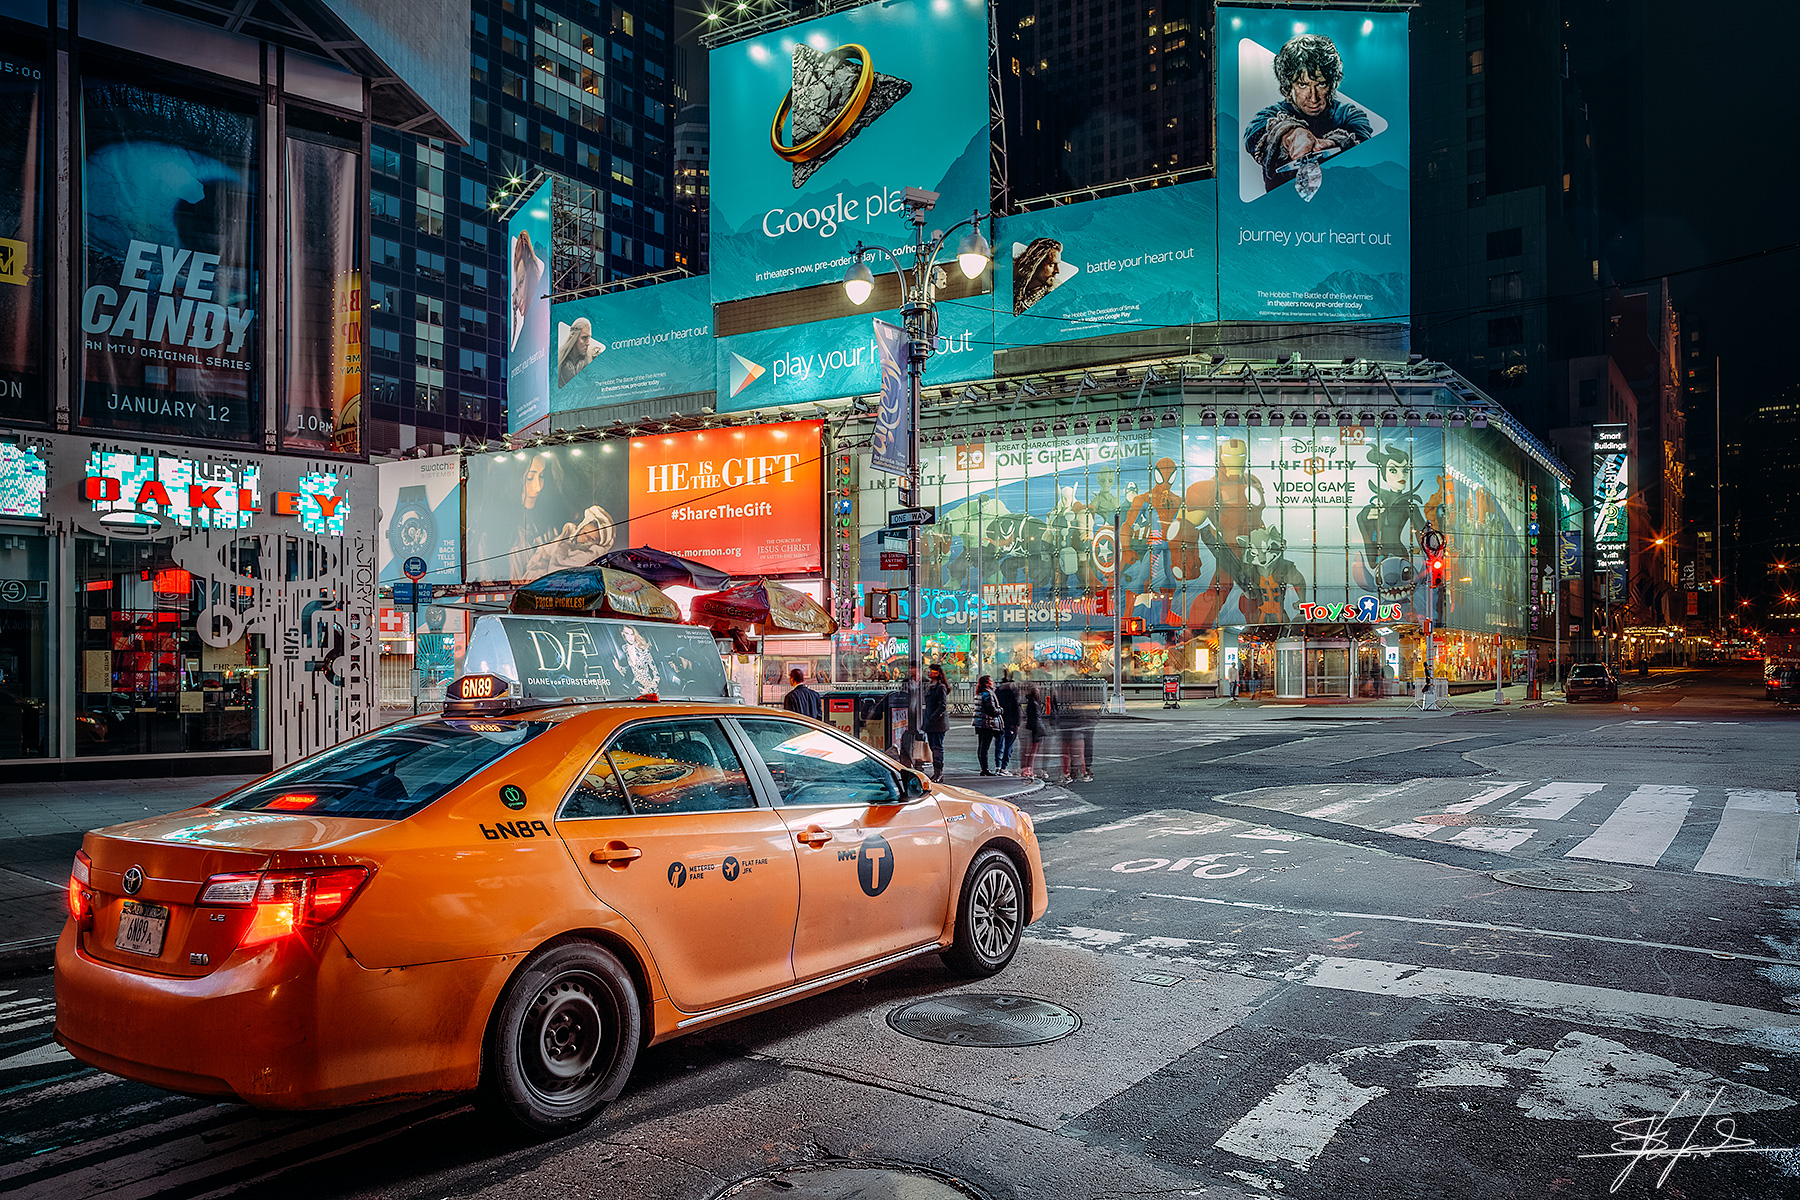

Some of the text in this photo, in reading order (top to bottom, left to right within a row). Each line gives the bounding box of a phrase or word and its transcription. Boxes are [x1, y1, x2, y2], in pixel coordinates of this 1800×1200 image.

[762, 186, 912, 238] Google pla
[1237, 226, 1392, 247] journey your heart out
[755, 251, 876, 282] in theaters now, pre-order tday
[1086, 247, 1195, 274] battle your heart out
[119, 239, 221, 300] EYE
[1257, 290, 1269, 298] The
[1292, 291, 1304, 299] The
[1304, 291, 1322, 300] Battle
[1353, 293, 1374, 301] Armies
[1315, 301, 1345, 309] pre-order
[1345, 301, 1363, 310] today
[81, 285, 255, 354] CANDY
[611, 325, 709, 350] command your heart out
[85, 339, 252, 371] AN MTV ORIGINAL SERIES
[772, 351, 815, 385] play
[817, 346, 866, 378] your
[937, 328, 974, 355] out
[107, 393, 230, 422] JANUARY 12
[298, 414, 333, 433] 10PM
[1600, 432, 1621, 440] Smart
[997, 444, 1020, 452] GREAT
[1020, 440, 1072, 451] CHARACTERS.
[1075, 437, 1101, 445] GREAT
[1594, 442, 1627, 450] Buildings
[998, 442, 1155, 467] ONE GREAT GAME.
[420, 462, 449, 472] swatch
[699, 461, 713, 475] IS
[721, 453, 800, 488] GIFT
[647, 462, 690, 493] HE
[690, 474, 721, 490] THE
[1273, 482, 1355, 492] VIDEO GAME
[86, 476, 343, 517] OAKLEY
[1276, 496, 1353, 504] NOW AVAILABLE
[671, 501, 772, 521] #ShareTheGift
[894, 512, 928, 523] ONE WAY
[757, 543, 811, 555] JESUS CHRIST
[535, 597, 585, 608] FRIED PICKLES!
[984, 584, 1032, 605] MARVEL
[945, 609, 1073, 625] SUPER HEROES
[461, 677, 493, 699] 6N89
[561, 678, 611, 686] FURSTENBERG
[689, 863, 715, 873] METERED
[742, 857, 768, 867] FLAT FARE
[837, 847, 886, 889] NYC T
[689, 872, 705, 881] FARE
[742, 867, 753, 875] JFK
[210, 913, 226, 922] LE
